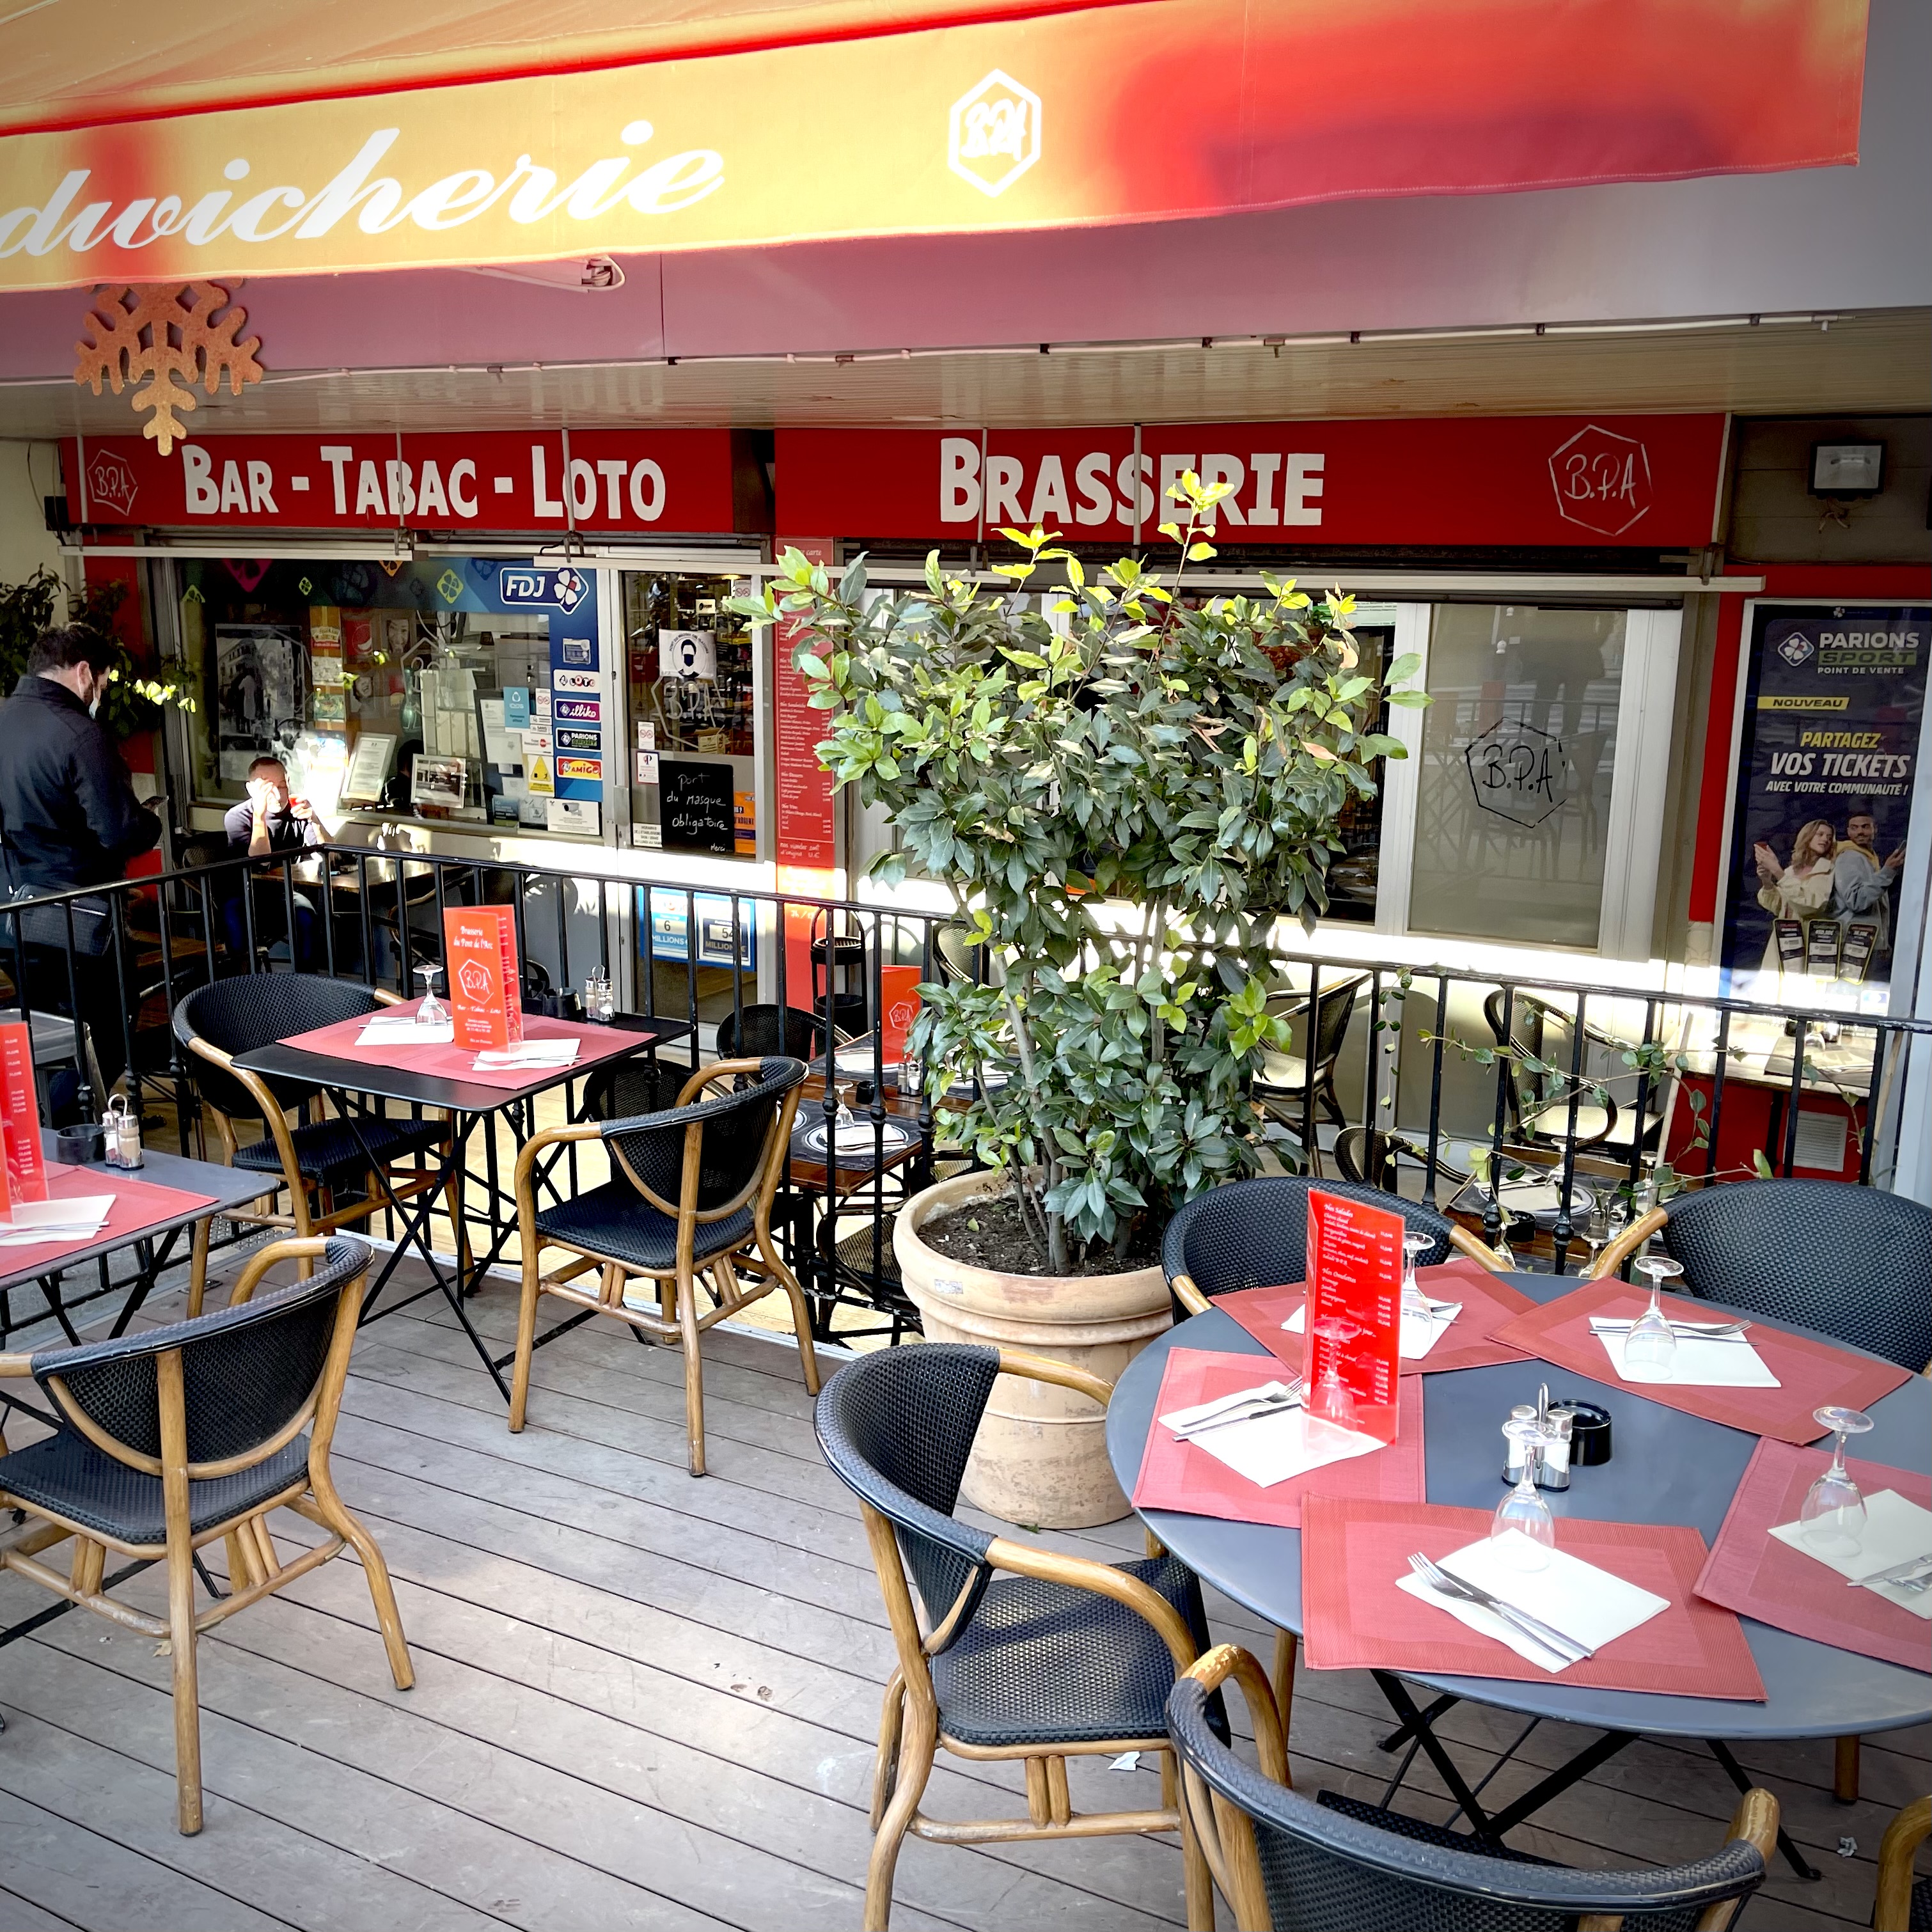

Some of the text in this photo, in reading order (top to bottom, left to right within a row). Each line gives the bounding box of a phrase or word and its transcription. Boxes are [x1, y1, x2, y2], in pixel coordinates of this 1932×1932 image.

[182, 444, 279, 514] BAR
[320, 446, 478, 518] TABAC
[532, 446, 666, 521] LOTO
[940, 437, 1325, 526] BRASSERIE
[506, 576, 546, 598] FDJ
[1819, 632, 1920, 648] PARIONS
[1822, 651, 1915, 664] SPORT
[569, 675, 595, 687] LOTO
[1772, 698, 1843, 707] NOUVEAU
[569, 704, 597, 718] illiko
[571, 732, 597, 741] PARIONS
[1800, 732, 1881, 749] PARTAGEZ
[1771, 752, 1912, 778] VOS TICKETS
[1766, 781, 1793, 792] AVEC
[1794, 781, 1826, 793] VOTRE
[1828, 782, 1903, 796] COMMUNAUTÉ
[666, 790, 679, 802] du
[664, 920, 671, 931] 6
[652, 934, 684, 945] MILLIONS
